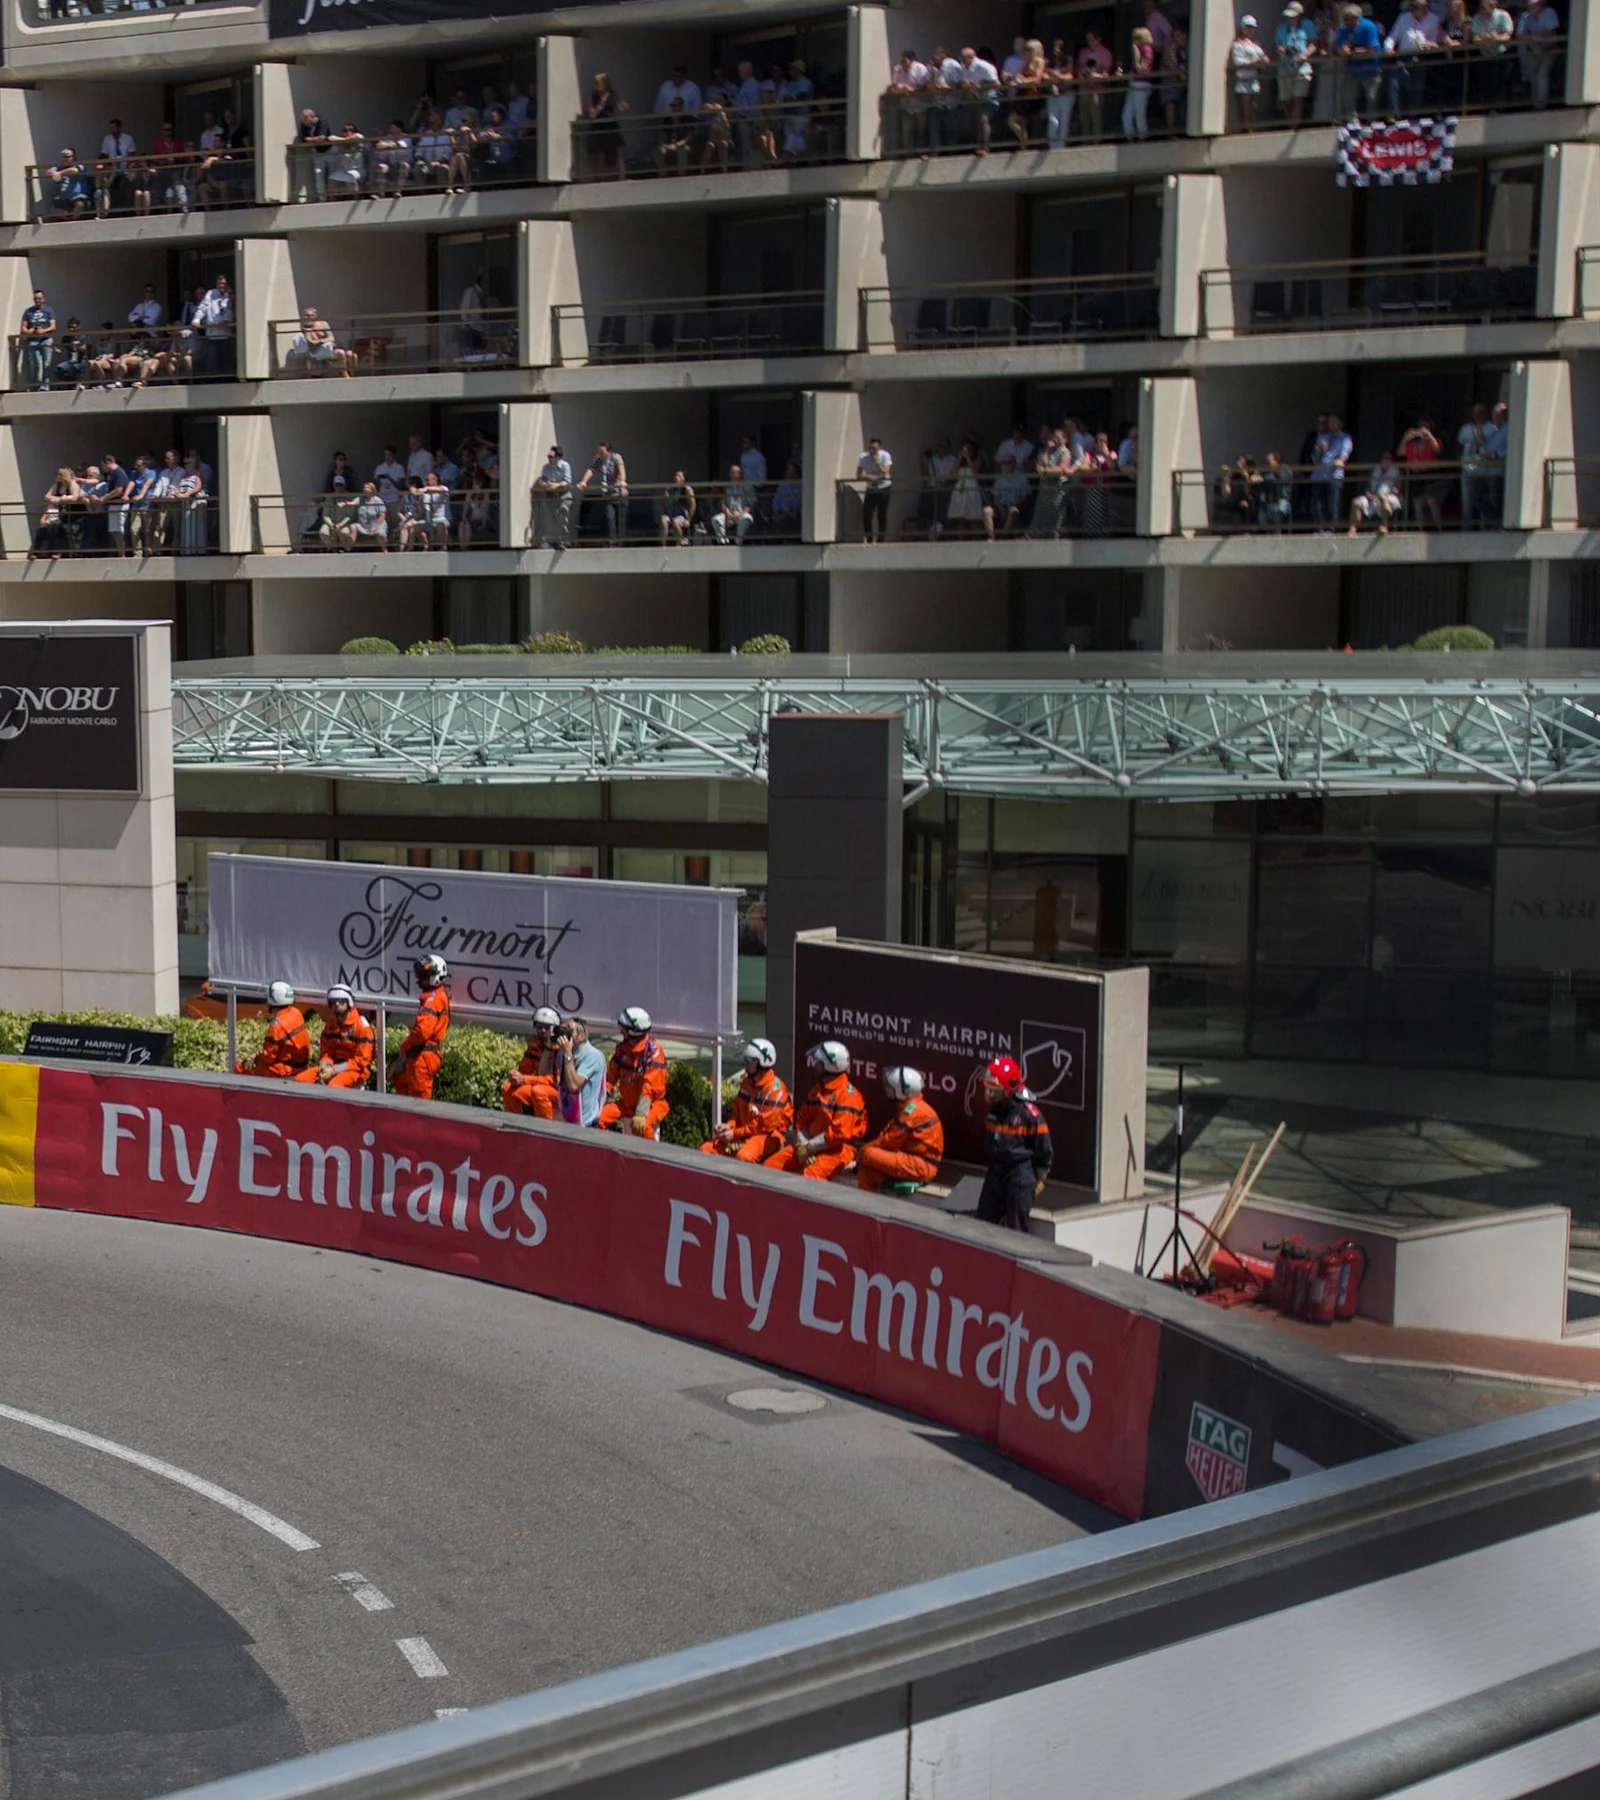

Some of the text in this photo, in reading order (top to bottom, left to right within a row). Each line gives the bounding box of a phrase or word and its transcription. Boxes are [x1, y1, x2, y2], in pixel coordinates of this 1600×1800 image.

[1361, 140, 1428, 159] LEWIS
[14, 687, 120, 711] NOBU
[30, 716, 118, 726] FAIRMONT MONTE CARLO
[338, 875, 581, 975] Fairmont
[337, 964, 452, 1000] MON
[30, 1035, 81, 1046] FAIRMONT
[84, 1039, 126, 1051] HAIRPIN
[807, 1022, 830, 1033] THE
[834, 1026, 885, 1043] WORLD'S
[889, 1035, 922, 1048] MOST
[926, 1042, 974, 1057] FAMOUS
[808, 1003, 1012, 1050] FAIRMONT HAIRPIN
[100, 1102, 548, 1248] Fly Emirates
[663, 1198, 1094, 1433] Fly Emirates
[1196, 1409, 1246, 1460] TAG
[1189, 1442, 1244, 1500] HEUER
